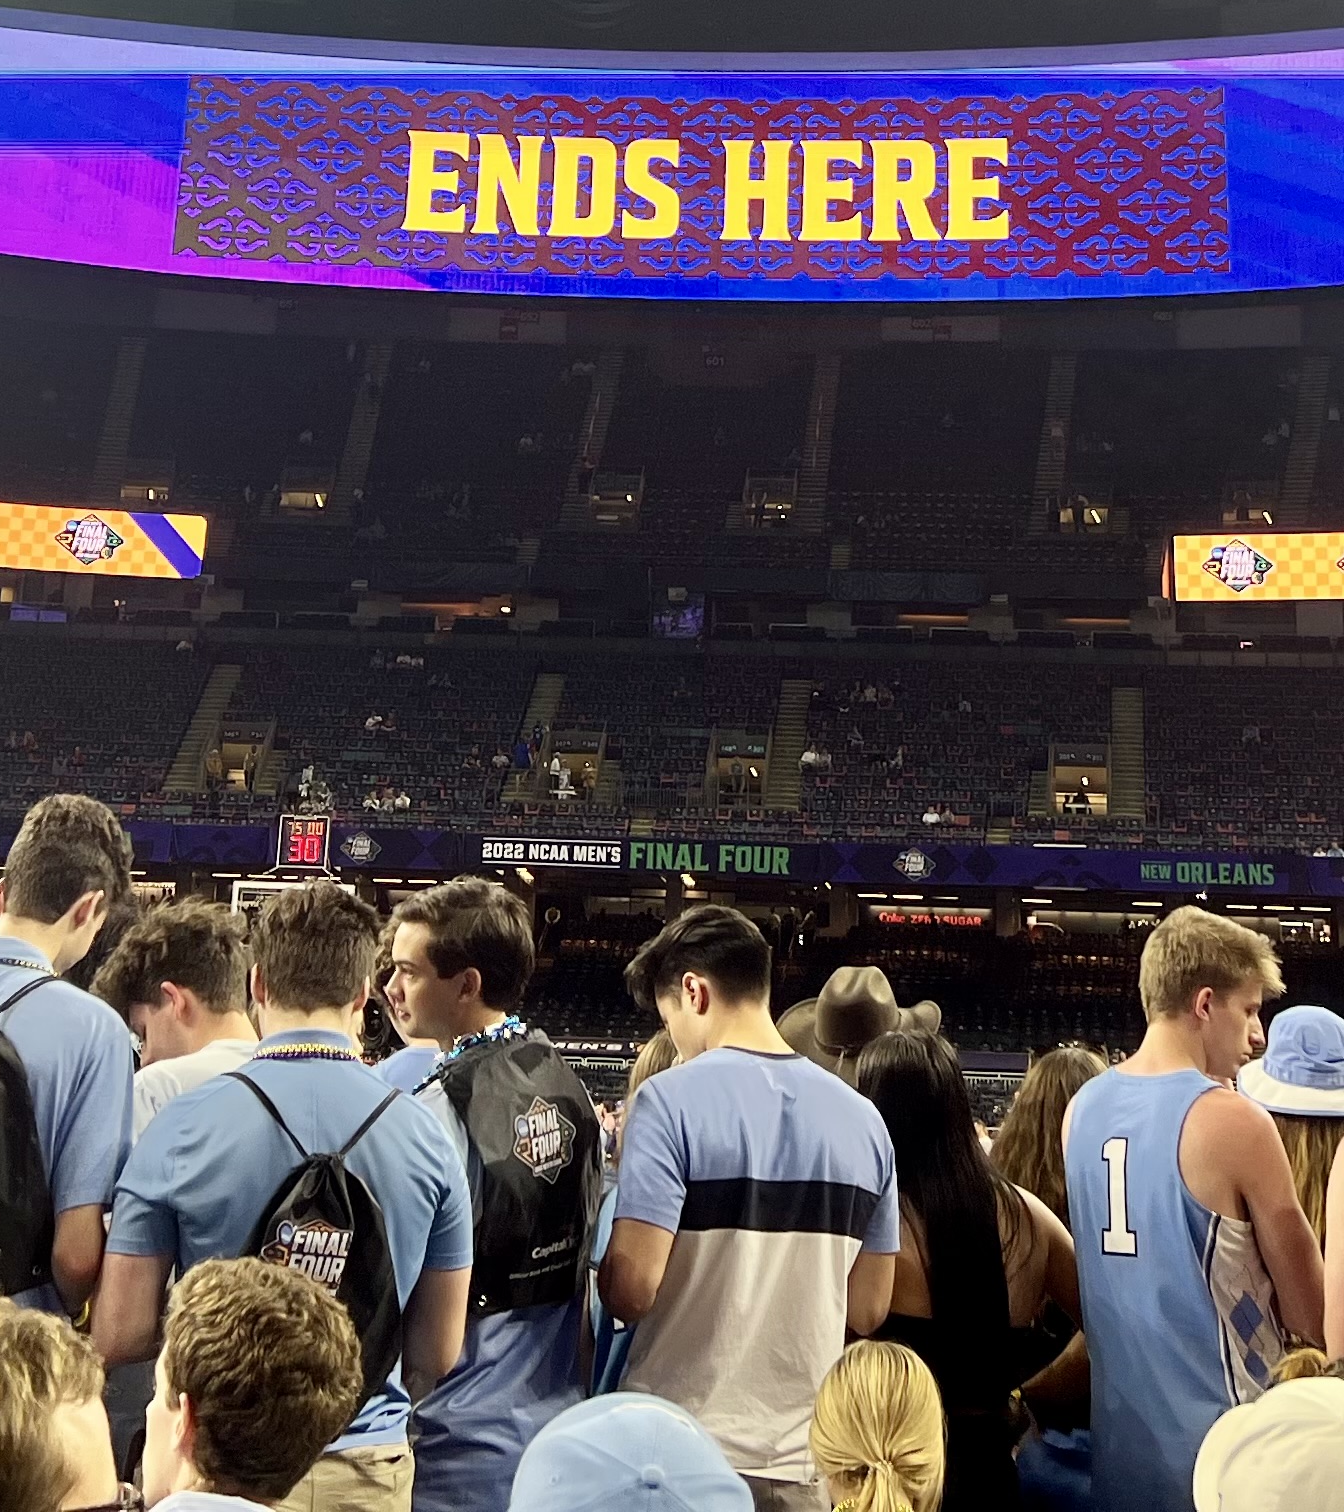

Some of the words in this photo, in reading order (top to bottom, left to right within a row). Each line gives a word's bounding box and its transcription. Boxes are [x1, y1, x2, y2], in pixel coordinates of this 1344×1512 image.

[401, 129, 681, 239] ENDS
[719, 136, 1009, 241] HERE
[705, 356, 725, 367] 601
[72, 537, 105, 554] FOUR
[76, 524, 108, 540] FINAL
[1220, 563, 1254, 579] FOUR
[1222, 550, 1255, 566] FINAL
[288, 836, 321, 863] 30
[482, 843, 524, 860] 2022
[528, 843, 569, 861] NCAA
[573, 844, 621, 863] MEN'S
[629, 842, 709, 872] FINAL
[718, 846, 790, 876] FOUR
[1141, 863, 1170, 880] NEW
[1176, 862, 1275, 885] ORLEANS
[879, 912, 906, 923] Coke
[942, 915, 982, 926] SUGAR
[528, 1108, 560, 1138] FINAL
[532, 1130, 561, 1162] FOUR
[1102, 1137, 1137, 1256] 1
[292, 1229, 353, 1258] FINAL
[289, 1254, 346, 1284] FOUR
